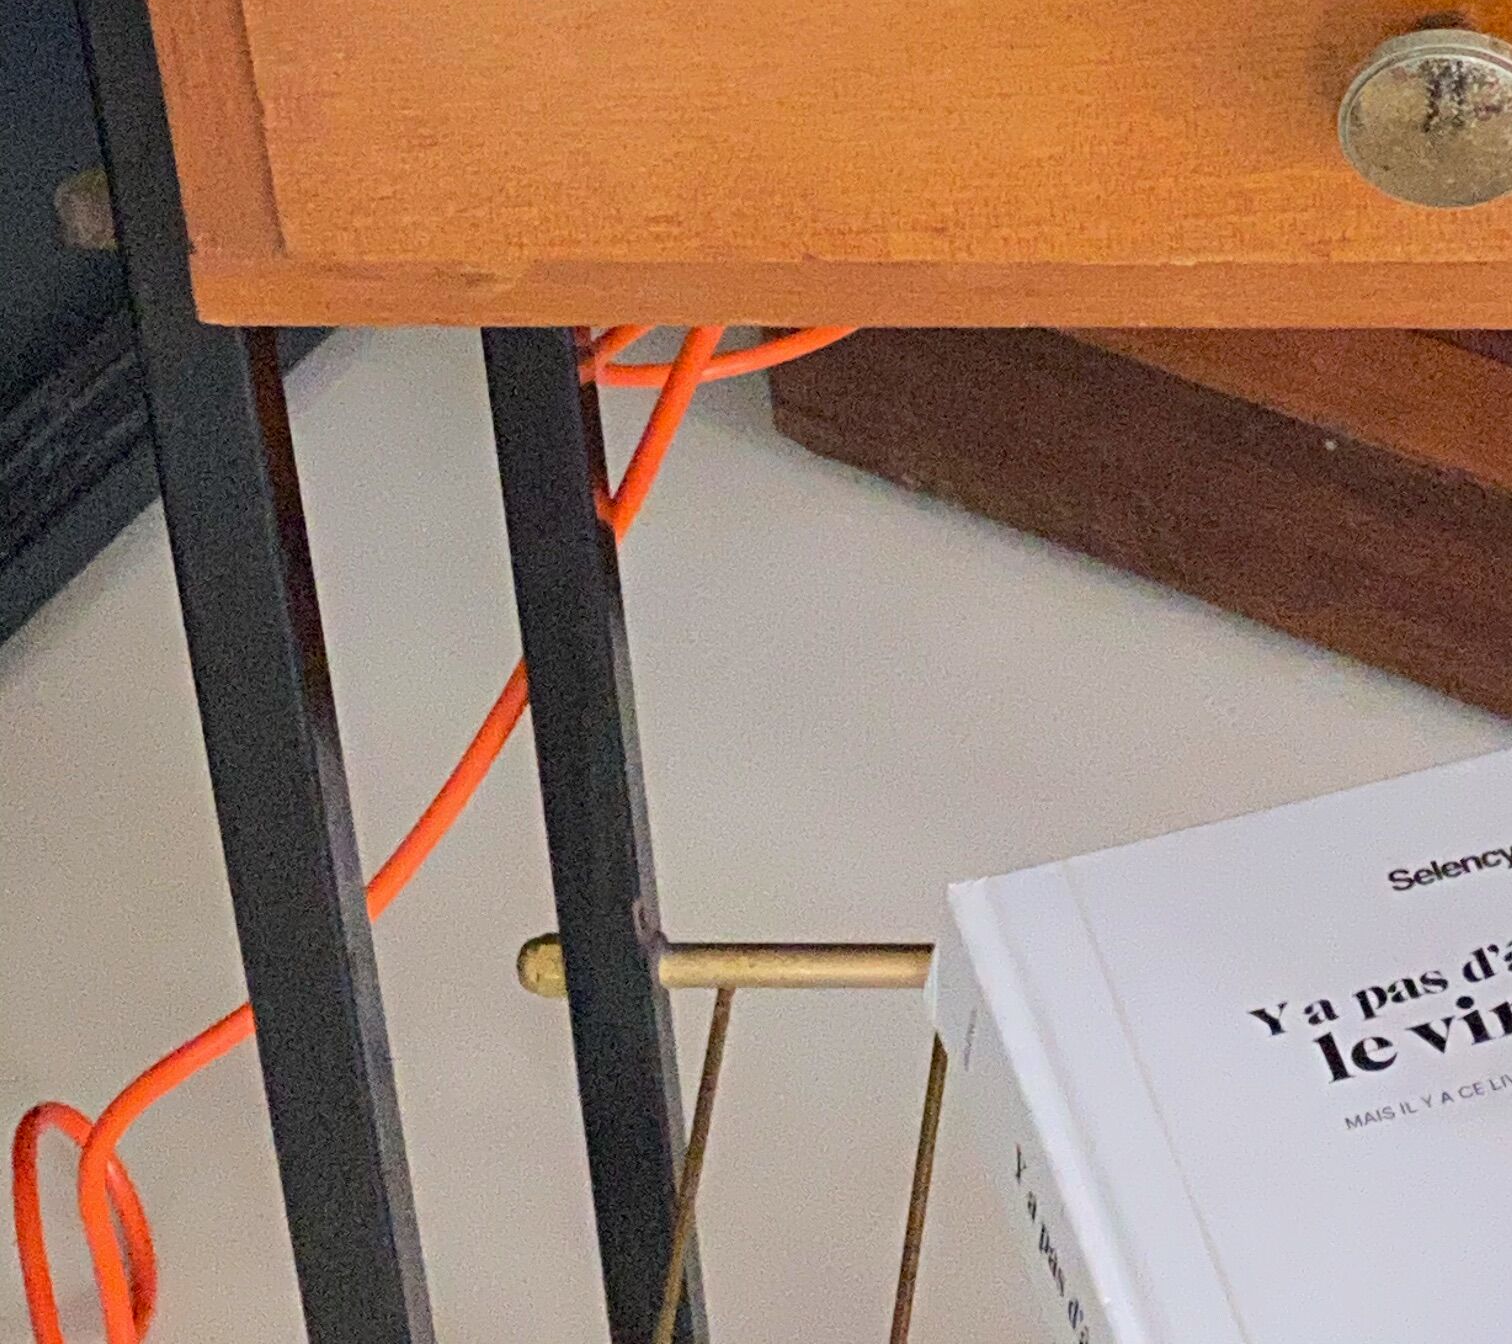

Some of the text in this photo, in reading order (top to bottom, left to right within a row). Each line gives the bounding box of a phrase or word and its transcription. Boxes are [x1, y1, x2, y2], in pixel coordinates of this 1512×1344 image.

[1249, 1000, 1288, 1038] Y
[1303, 997, 1340, 1027] a
[1352, 968, 1450, 1021] pas
[1312, 1031, 1399, 1084] le
[1344, 1103, 1395, 1130] MAIS
[1400, 1101, 1417, 1116] IL
[1420, 1094, 1433, 1108] Y
[1441, 1090, 1455, 1105] A
[1457, 1081, 1486, 1100] CE
